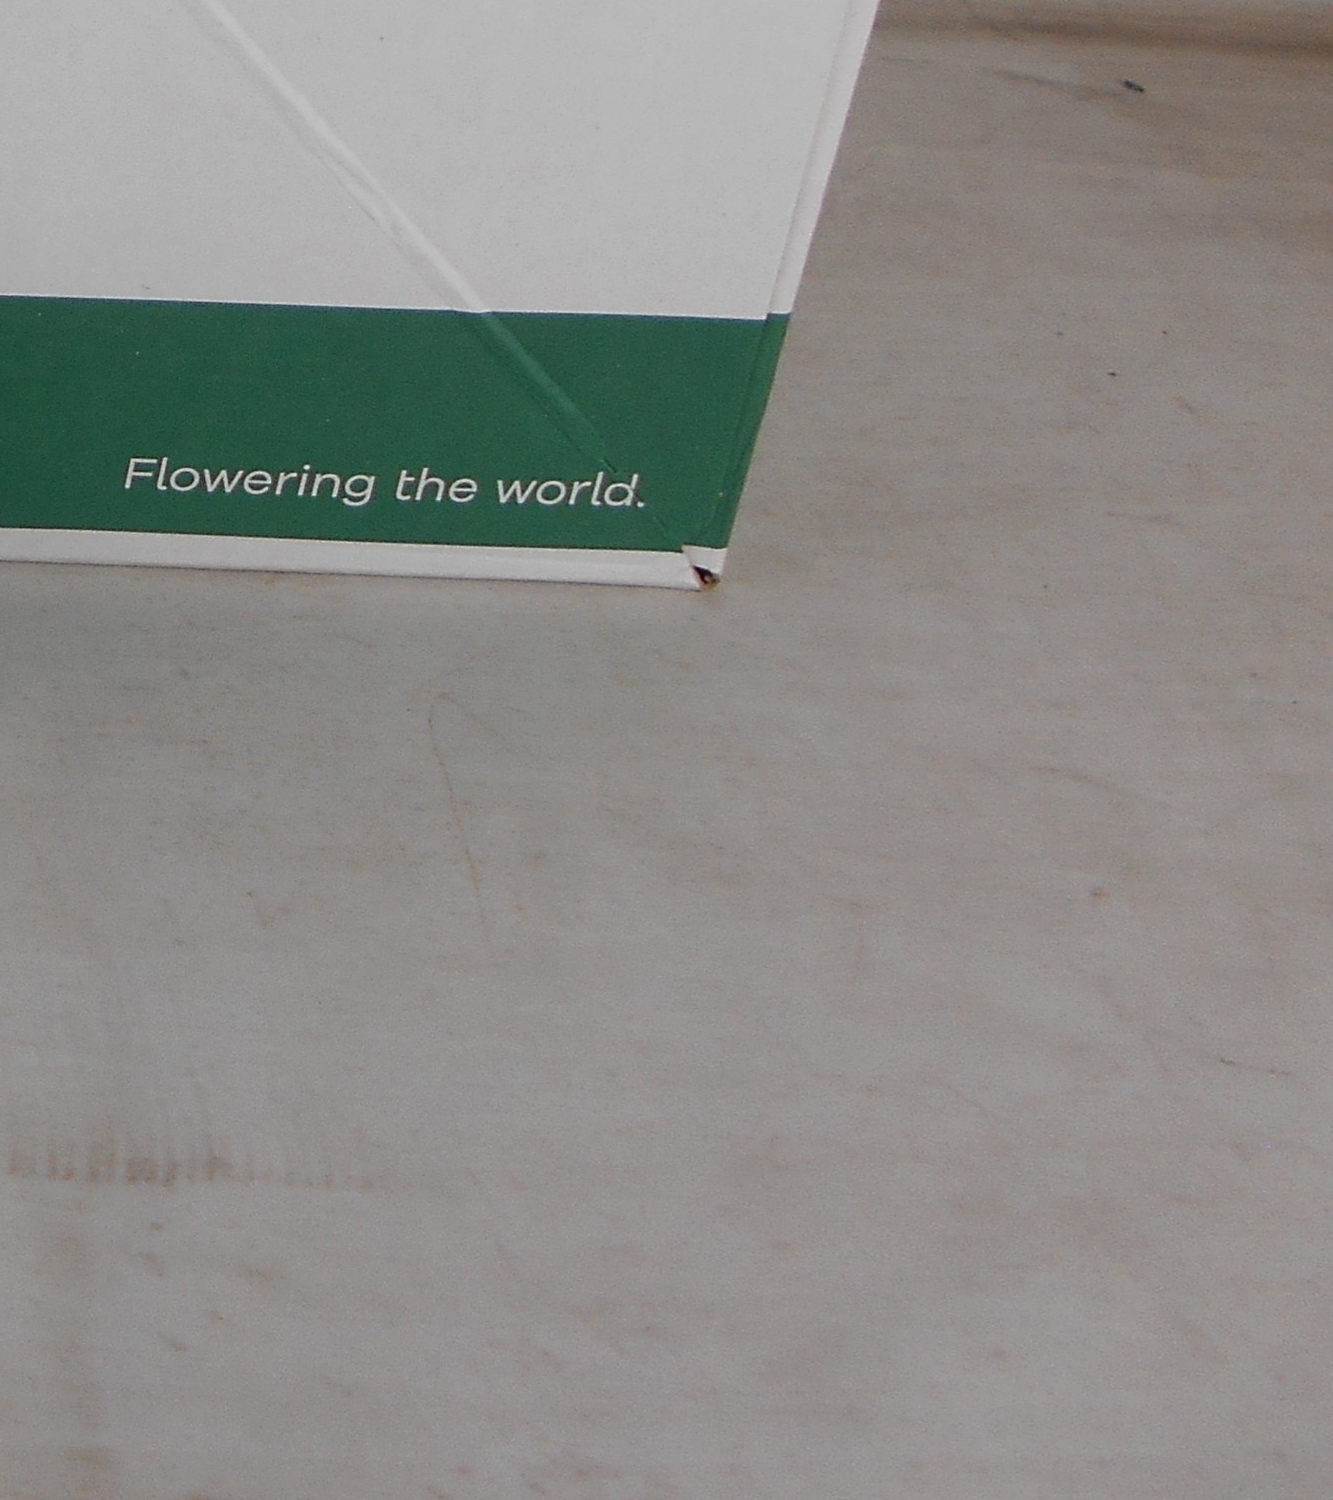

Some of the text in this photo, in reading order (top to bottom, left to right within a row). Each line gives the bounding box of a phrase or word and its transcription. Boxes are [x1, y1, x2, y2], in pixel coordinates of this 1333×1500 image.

[122, 455, 647, 510] Flowering the world.
